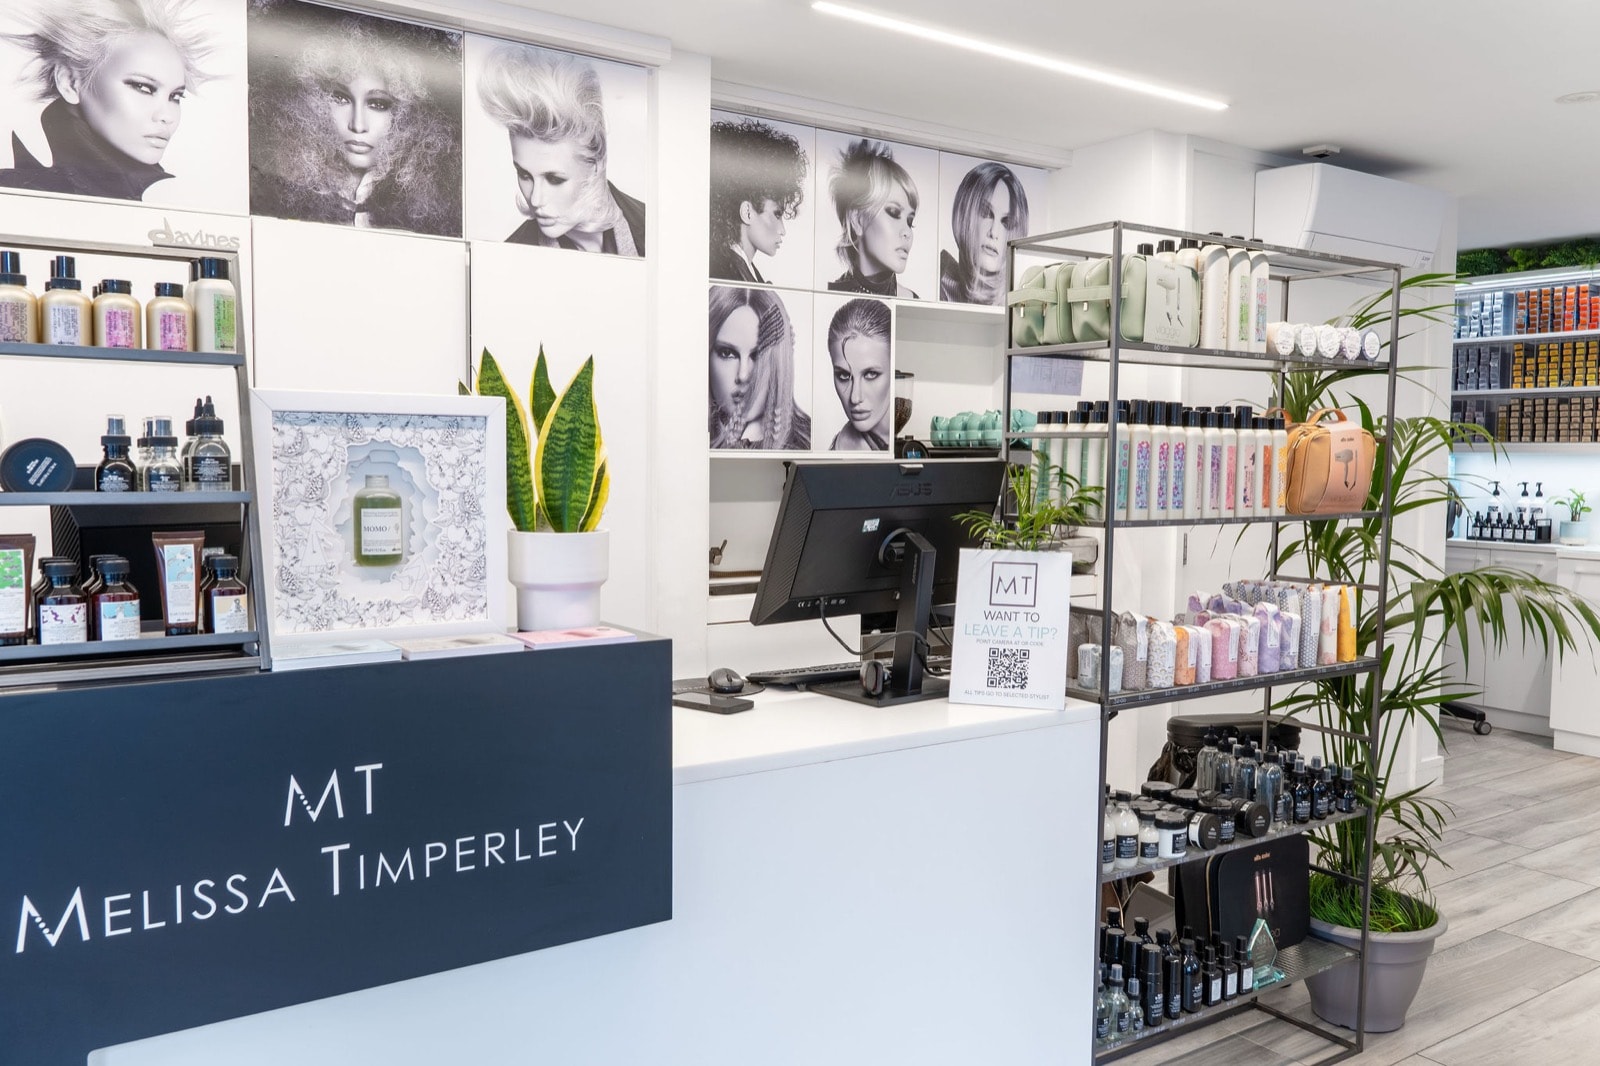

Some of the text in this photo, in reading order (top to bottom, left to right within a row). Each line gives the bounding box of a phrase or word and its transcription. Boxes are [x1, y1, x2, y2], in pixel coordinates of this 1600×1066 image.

[147, 217, 240, 249] davines
[984, 610, 1040, 623] WANT TO
[964, 624, 1058, 640] LEAVE A TIP?
[16, 817, 585, 954] MELISSA TIMPERLEY
